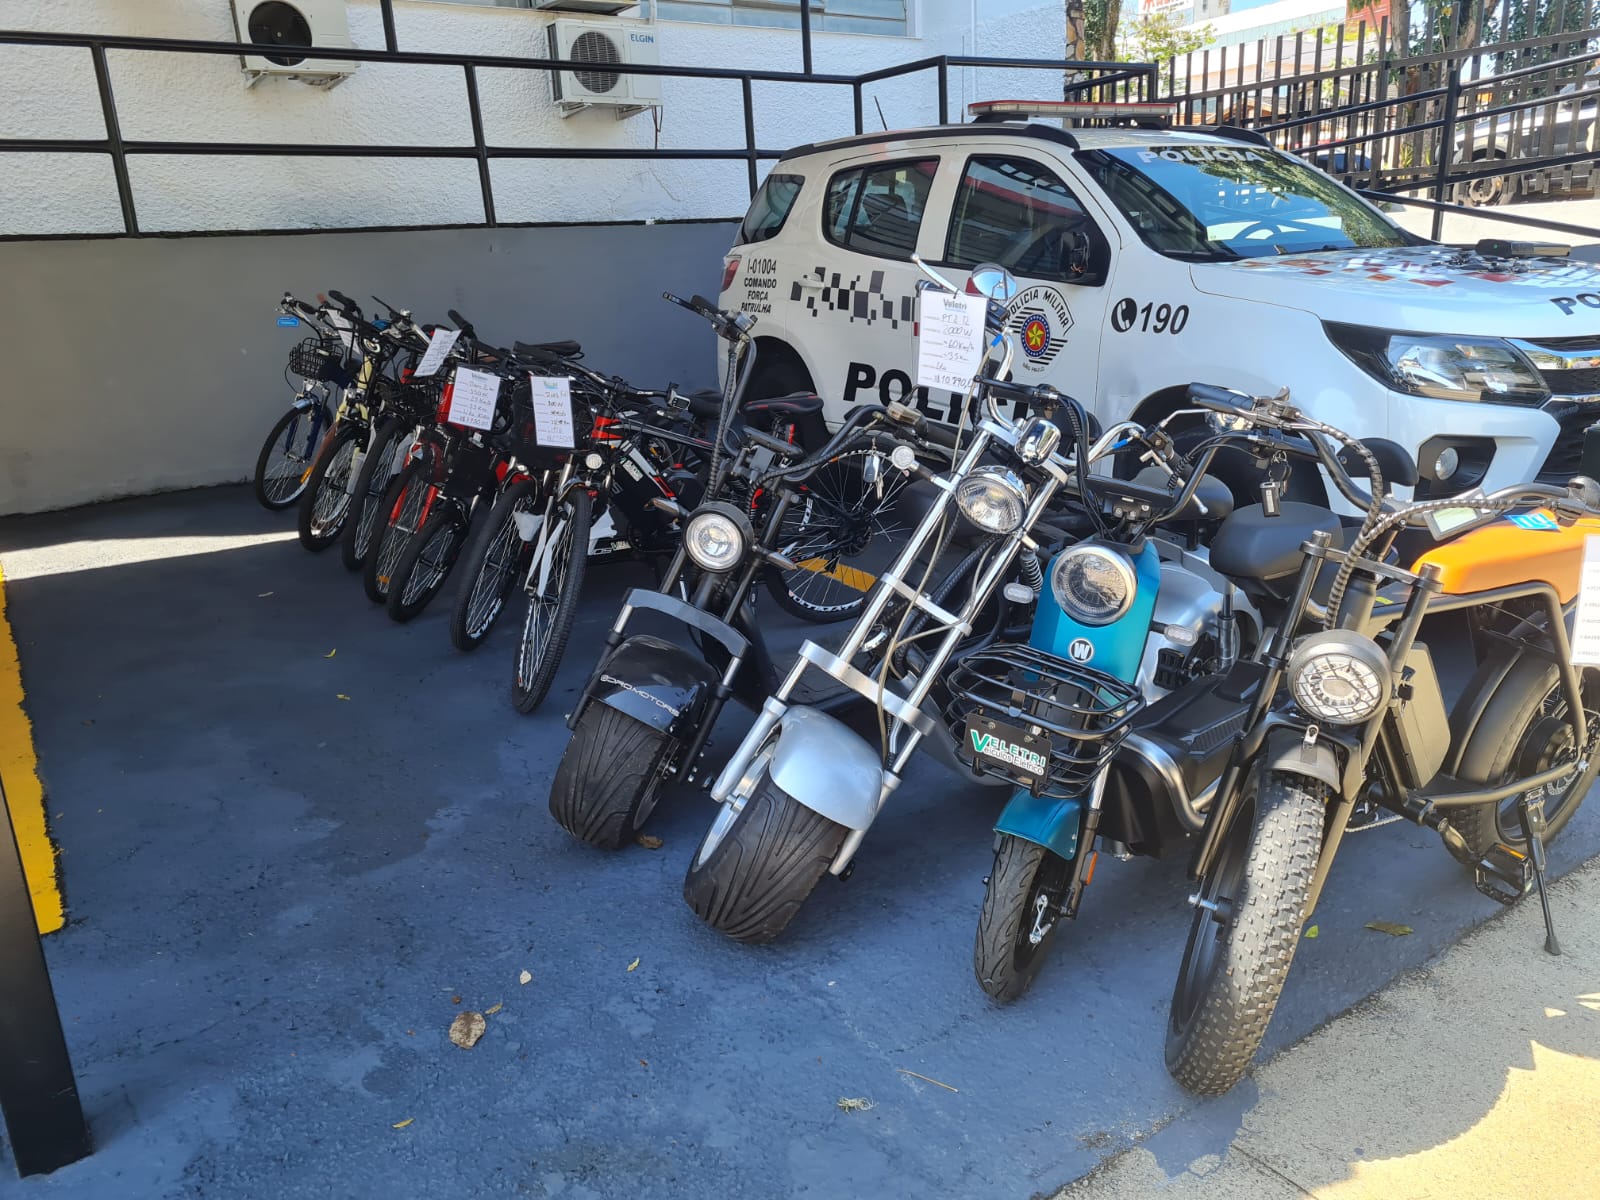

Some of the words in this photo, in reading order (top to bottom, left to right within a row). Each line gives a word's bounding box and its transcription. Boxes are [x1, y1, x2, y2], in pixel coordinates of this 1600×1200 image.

[630, 34, 654, 43] ELGIN
[747, 258, 777, 274] I-01004
[744, 277, 777, 288] COMANDO
[747, 290, 768, 302] FORÇA
[741, 302, 771, 313] PATRULHA
[1043, 290, 1070, 328] MILITAR
[1141, 302, 1189, 334] 190
[1074, 642, 1090, 659] W
[970, 729, 1046, 767] VELETRI
